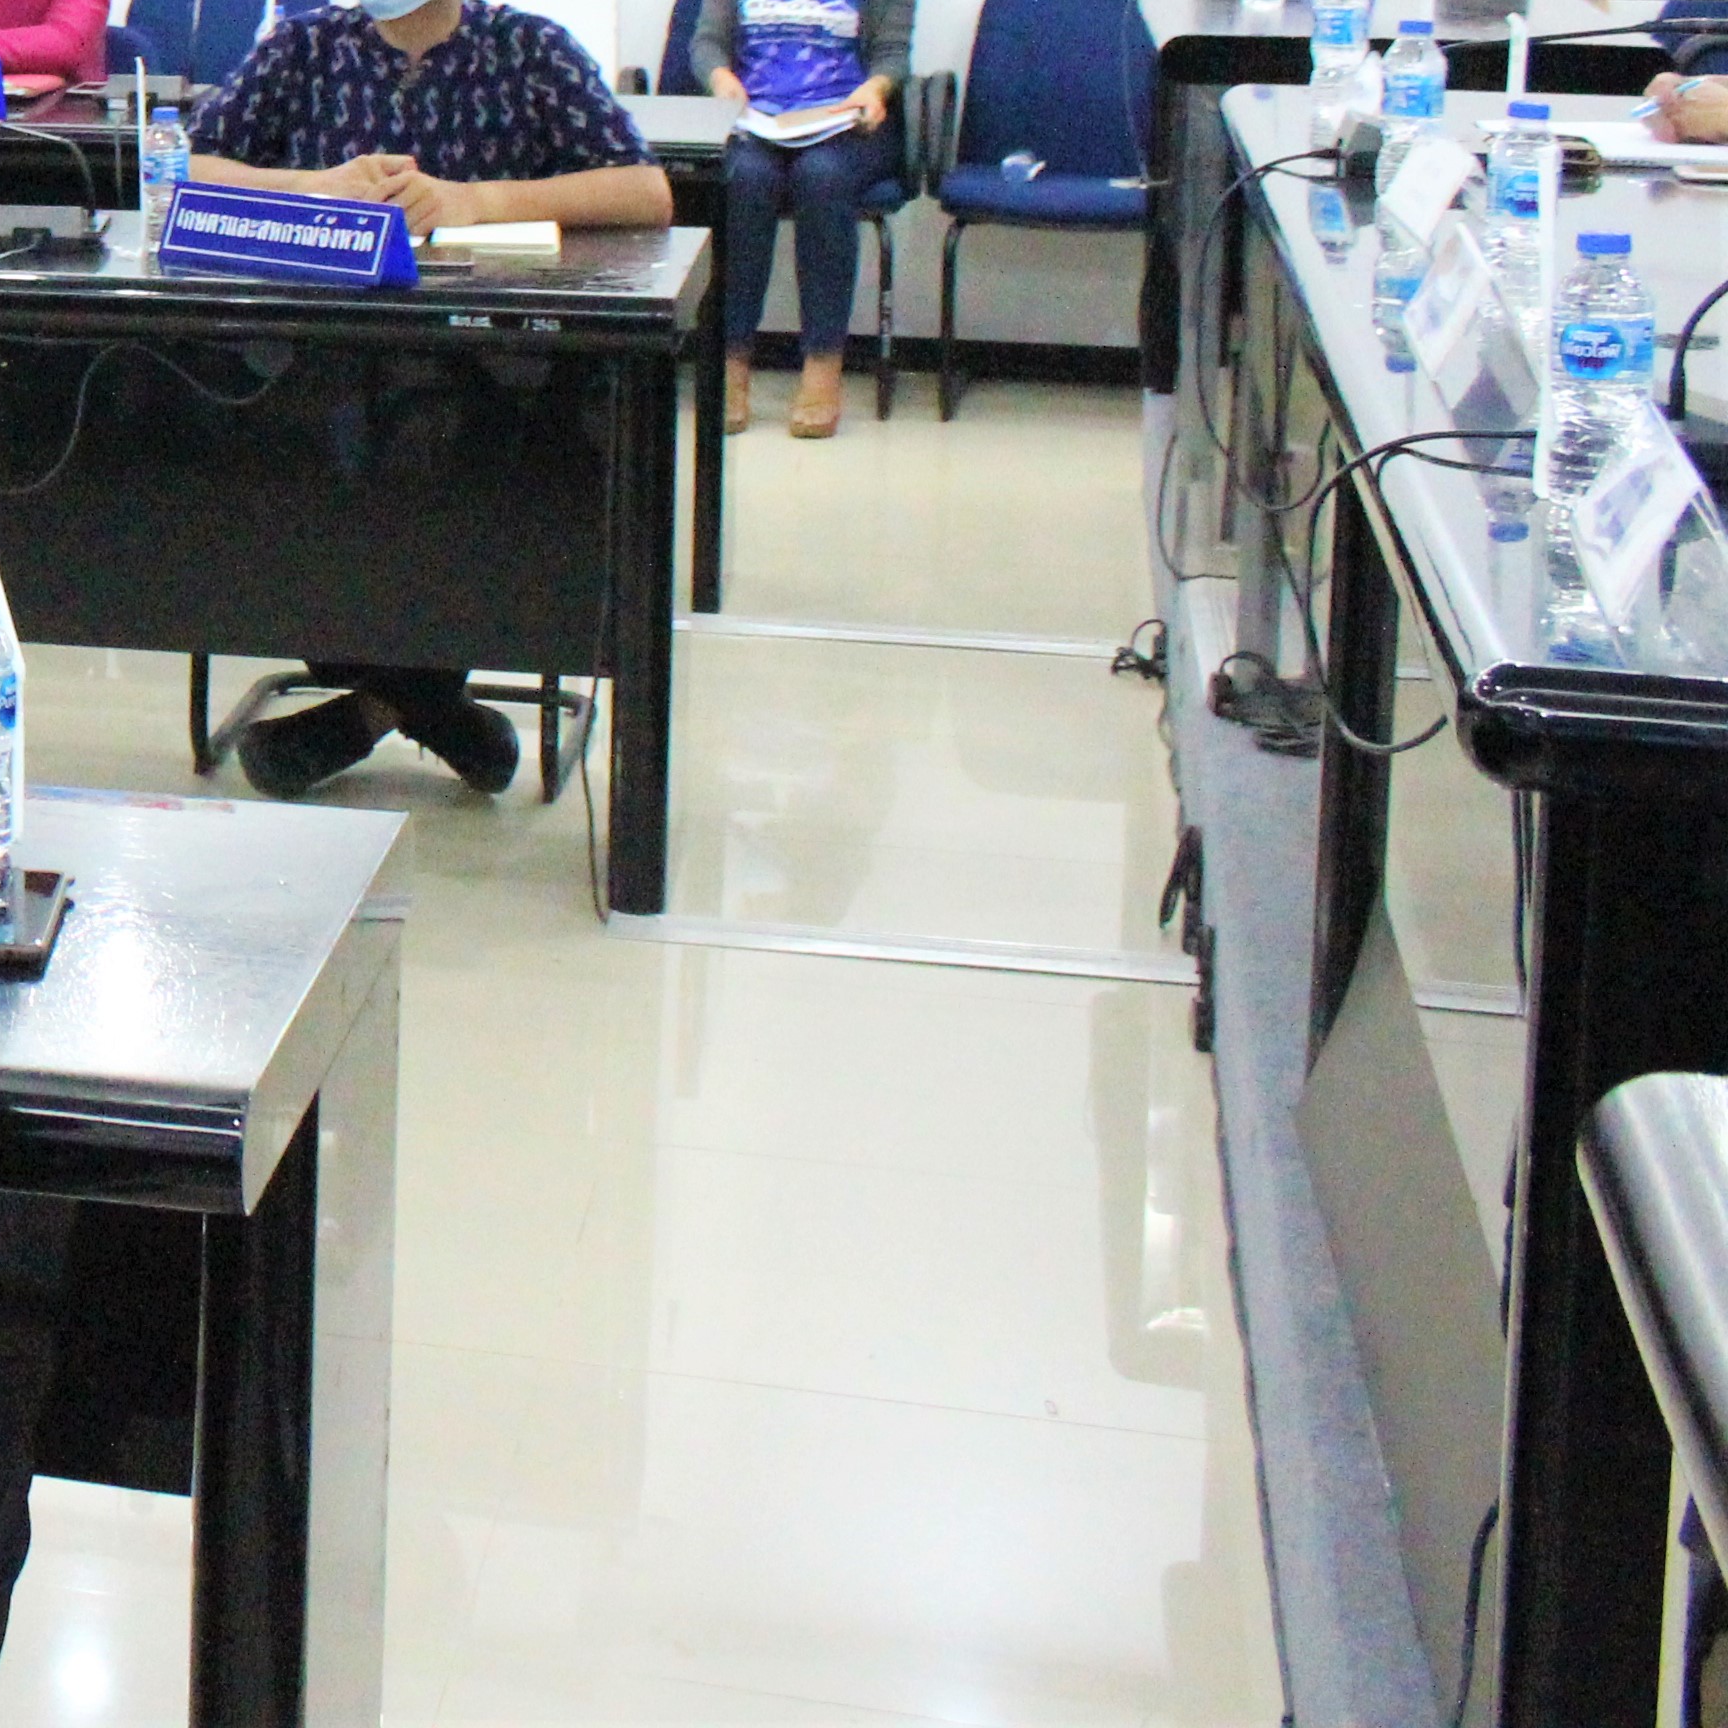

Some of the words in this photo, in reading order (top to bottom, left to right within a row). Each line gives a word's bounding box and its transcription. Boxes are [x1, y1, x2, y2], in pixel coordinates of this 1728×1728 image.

[177, 208, 376, 252] เกษตรและสหกรณ์จังหวัด
